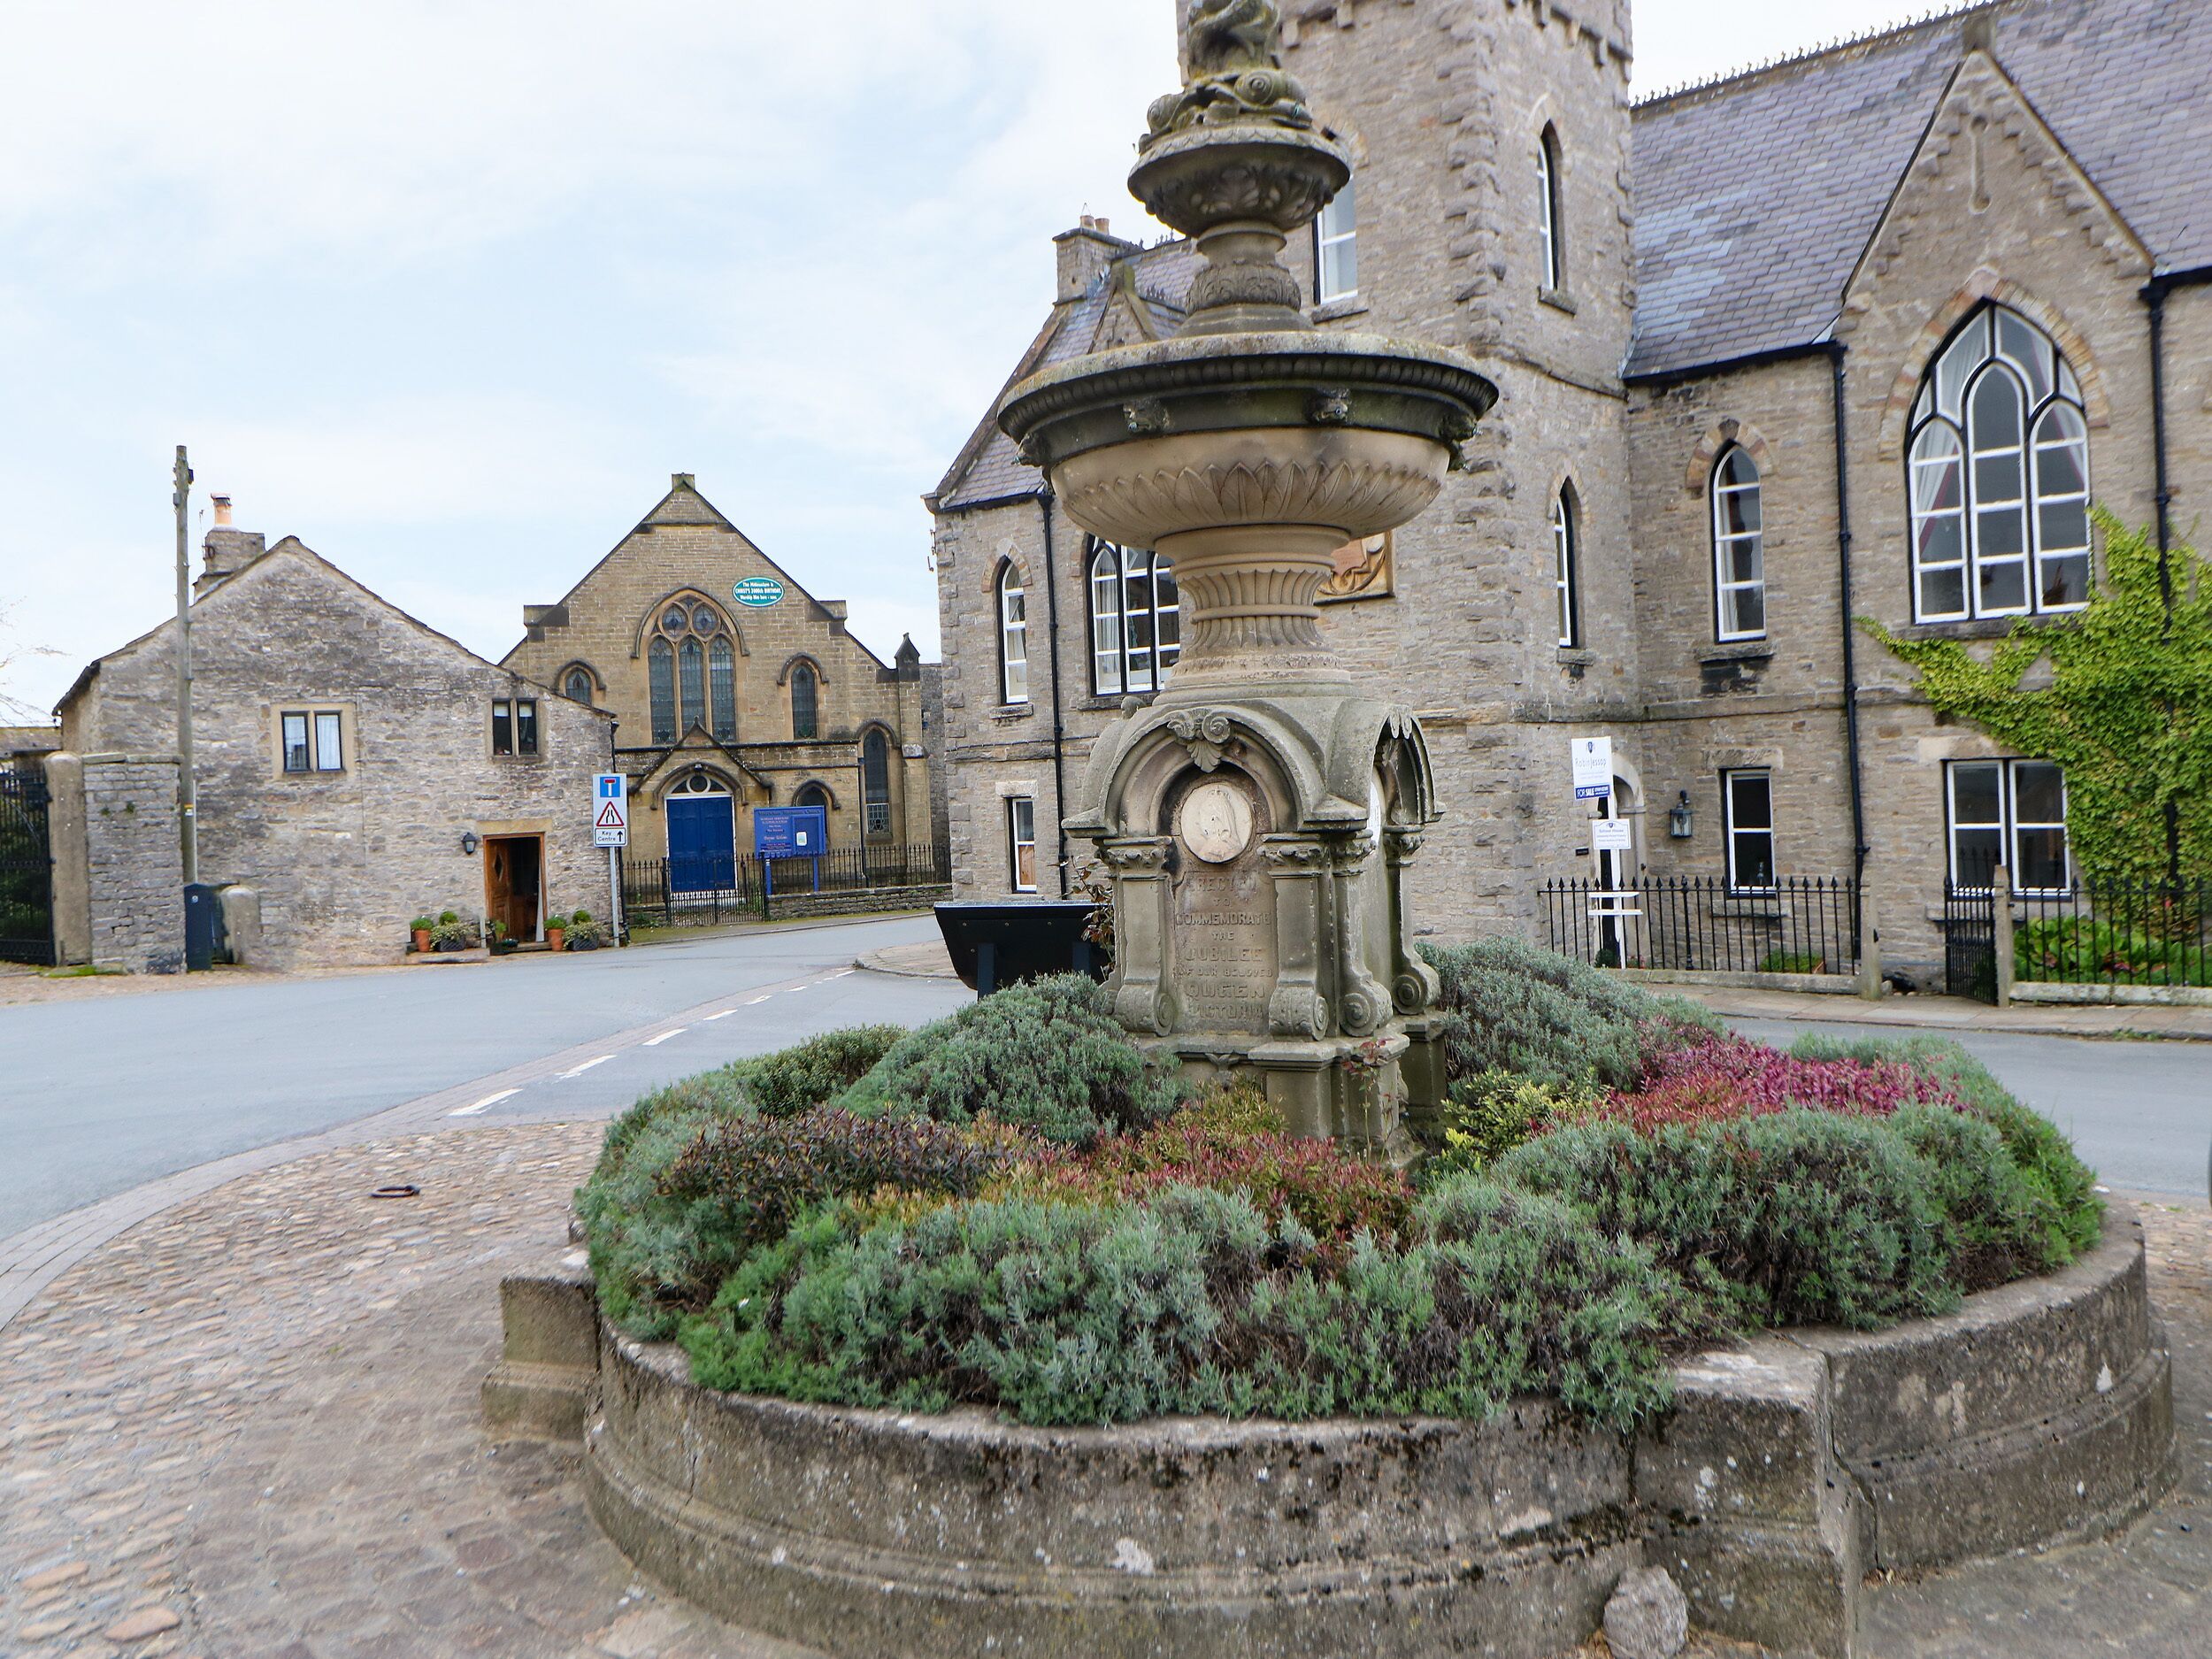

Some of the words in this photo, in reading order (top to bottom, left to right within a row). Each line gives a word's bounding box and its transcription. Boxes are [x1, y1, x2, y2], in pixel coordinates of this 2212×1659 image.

[1577, 789, 1585, 797] FOR
[1586, 787, 1595, 796] SALE
[1213, 898, 1232, 907] TO
[1175, 912, 1271, 926] COMMEMORATE
[1211, 931, 1235, 941] THE
[1184, 946, 1263, 962] JUBILEE
[1197, 967, 1218, 978] OUR
[1223, 968, 1273, 978] BELOVED
[1185, 981, 1265, 1001] QUEEN
[1189, 1003, 1263, 1021] VICTORIA
